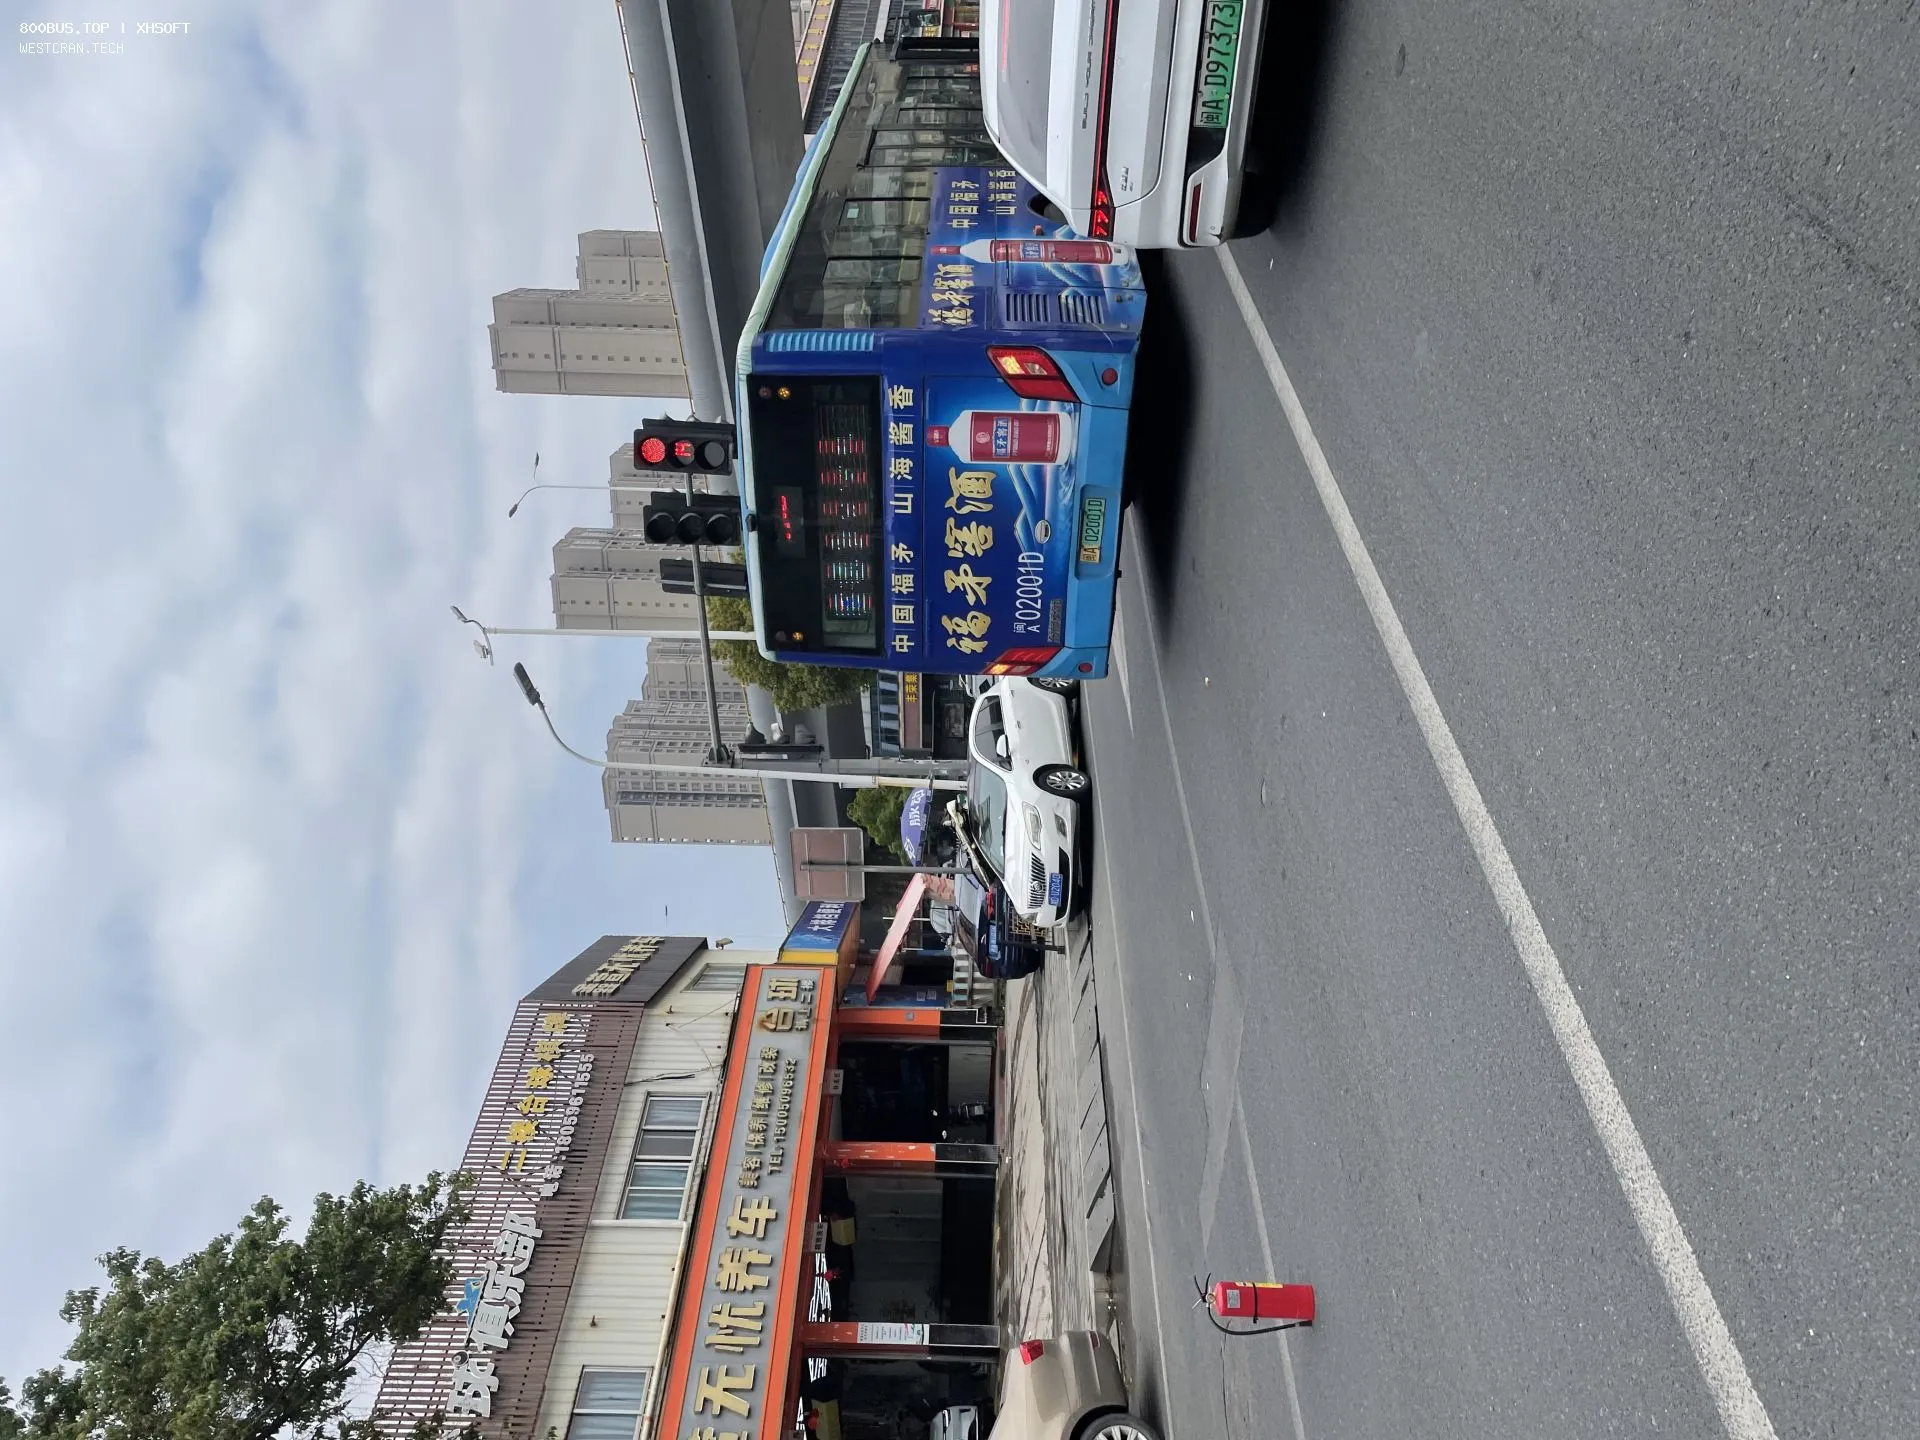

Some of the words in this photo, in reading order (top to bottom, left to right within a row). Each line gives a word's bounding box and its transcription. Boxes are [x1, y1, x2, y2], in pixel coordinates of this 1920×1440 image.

[946, 180, 979, 228] 中国福矛
[888, 384, 914, 514] 山海酱香
[891, 542, 914, 652] 中国福矛
[941, 466, 996, 654] 福矛窖酒
[760, 976, 800, 1032] 台球
[500, 1012, 571, 1172] 二楼台球棋牌
[440, 1210, 543, 1440] 球俱乐部
